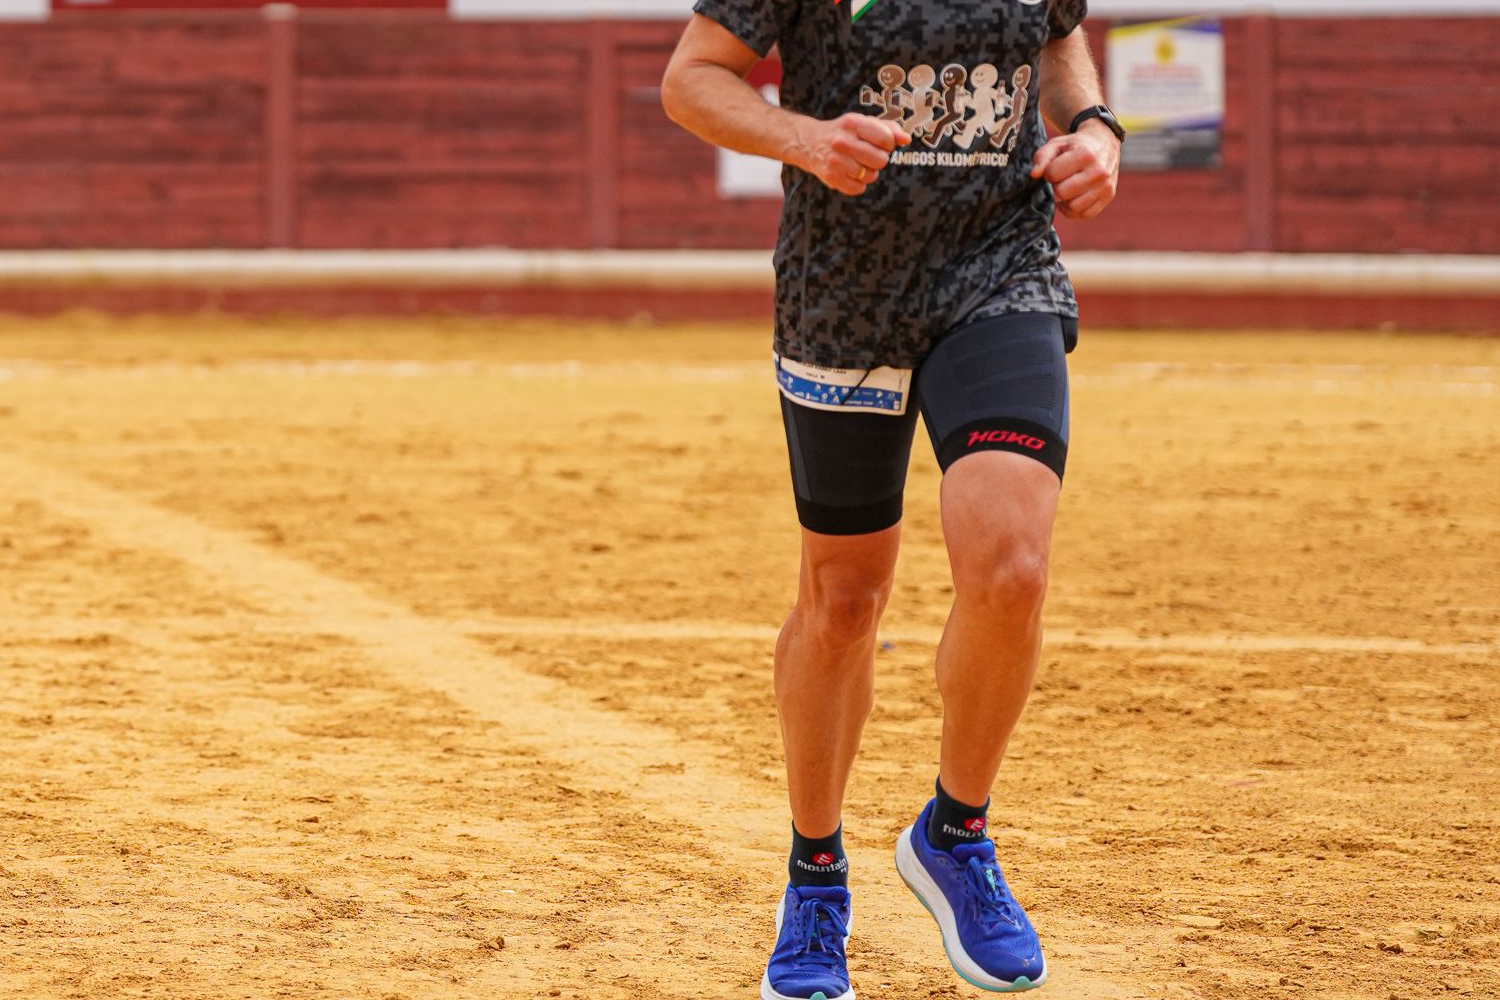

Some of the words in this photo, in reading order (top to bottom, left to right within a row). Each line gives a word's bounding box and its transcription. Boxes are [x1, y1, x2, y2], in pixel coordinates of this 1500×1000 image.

[890, 151, 936, 166] AMIGOS
[968, 429, 1046, 450] HOKO
[797, 857, 847, 873] mountain
